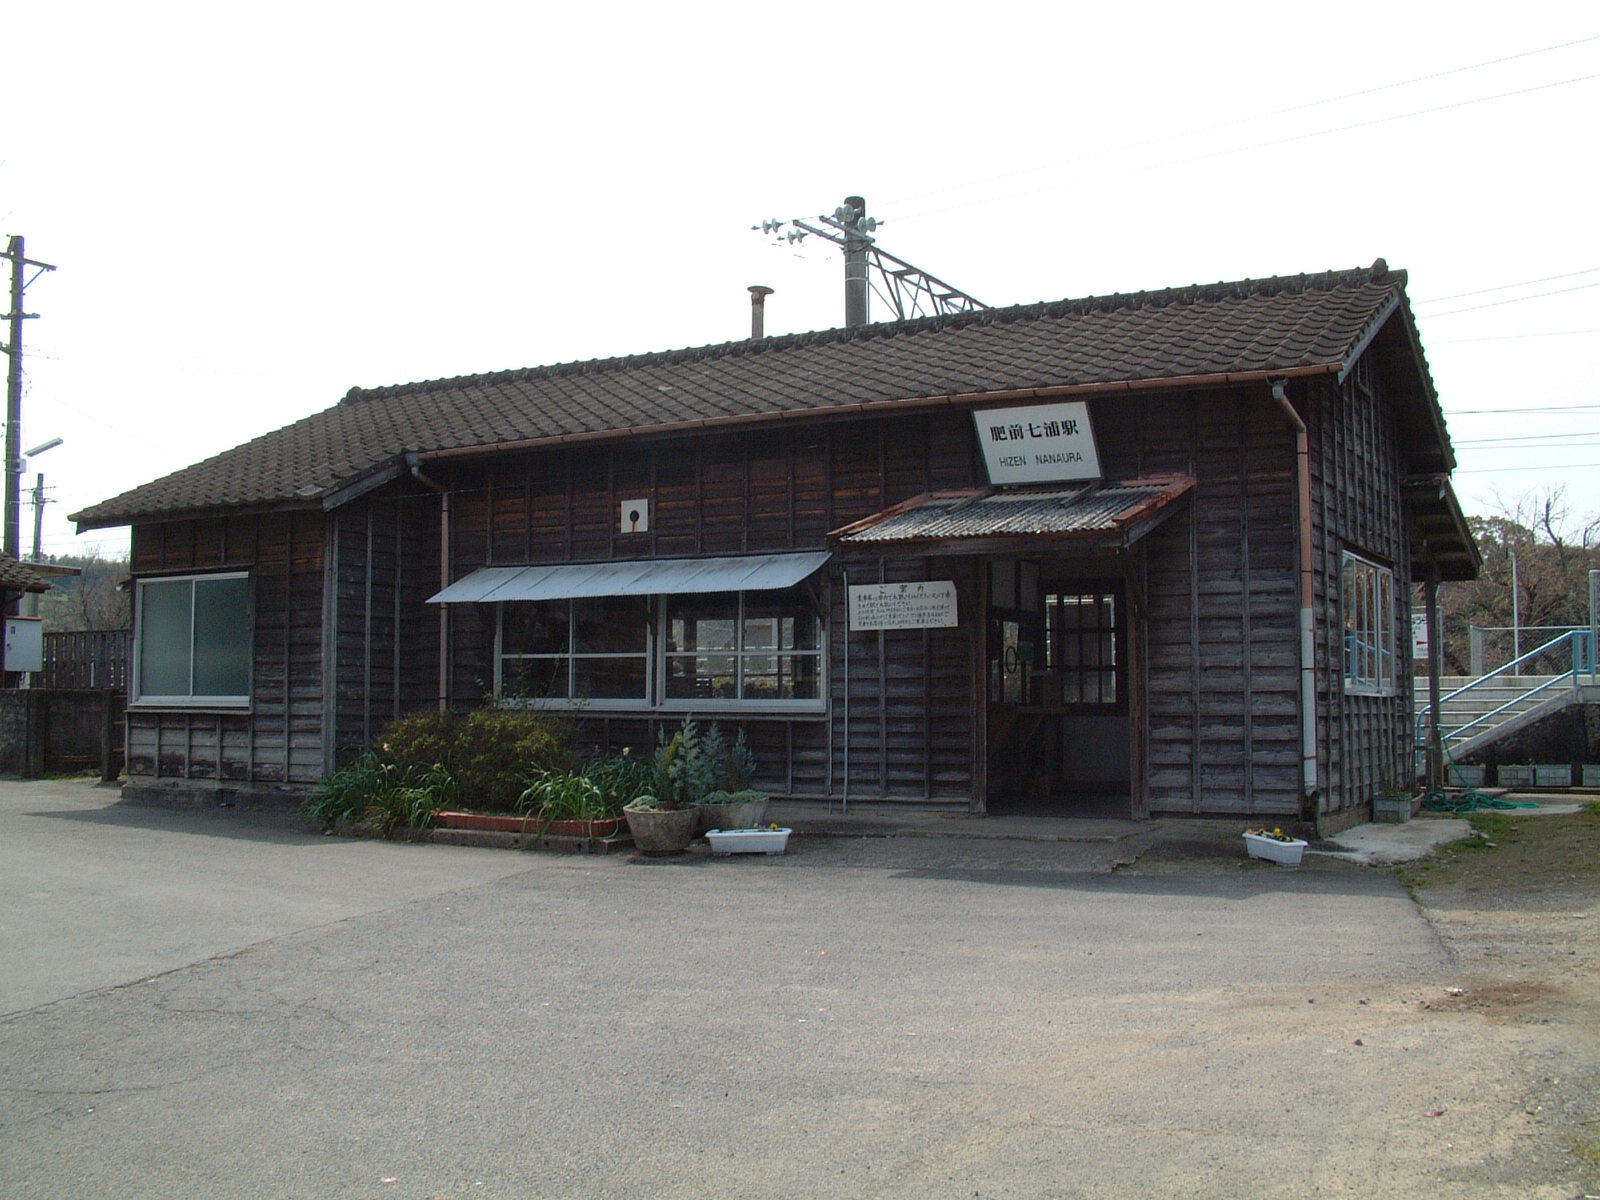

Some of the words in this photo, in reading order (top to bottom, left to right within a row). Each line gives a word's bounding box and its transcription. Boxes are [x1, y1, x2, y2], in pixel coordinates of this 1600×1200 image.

[990, 419, 1079, 442] 肥前七浦駅
[999, 455, 1027, 468] HIZEN
[1035, 451, 1083, 465] NANAURA
